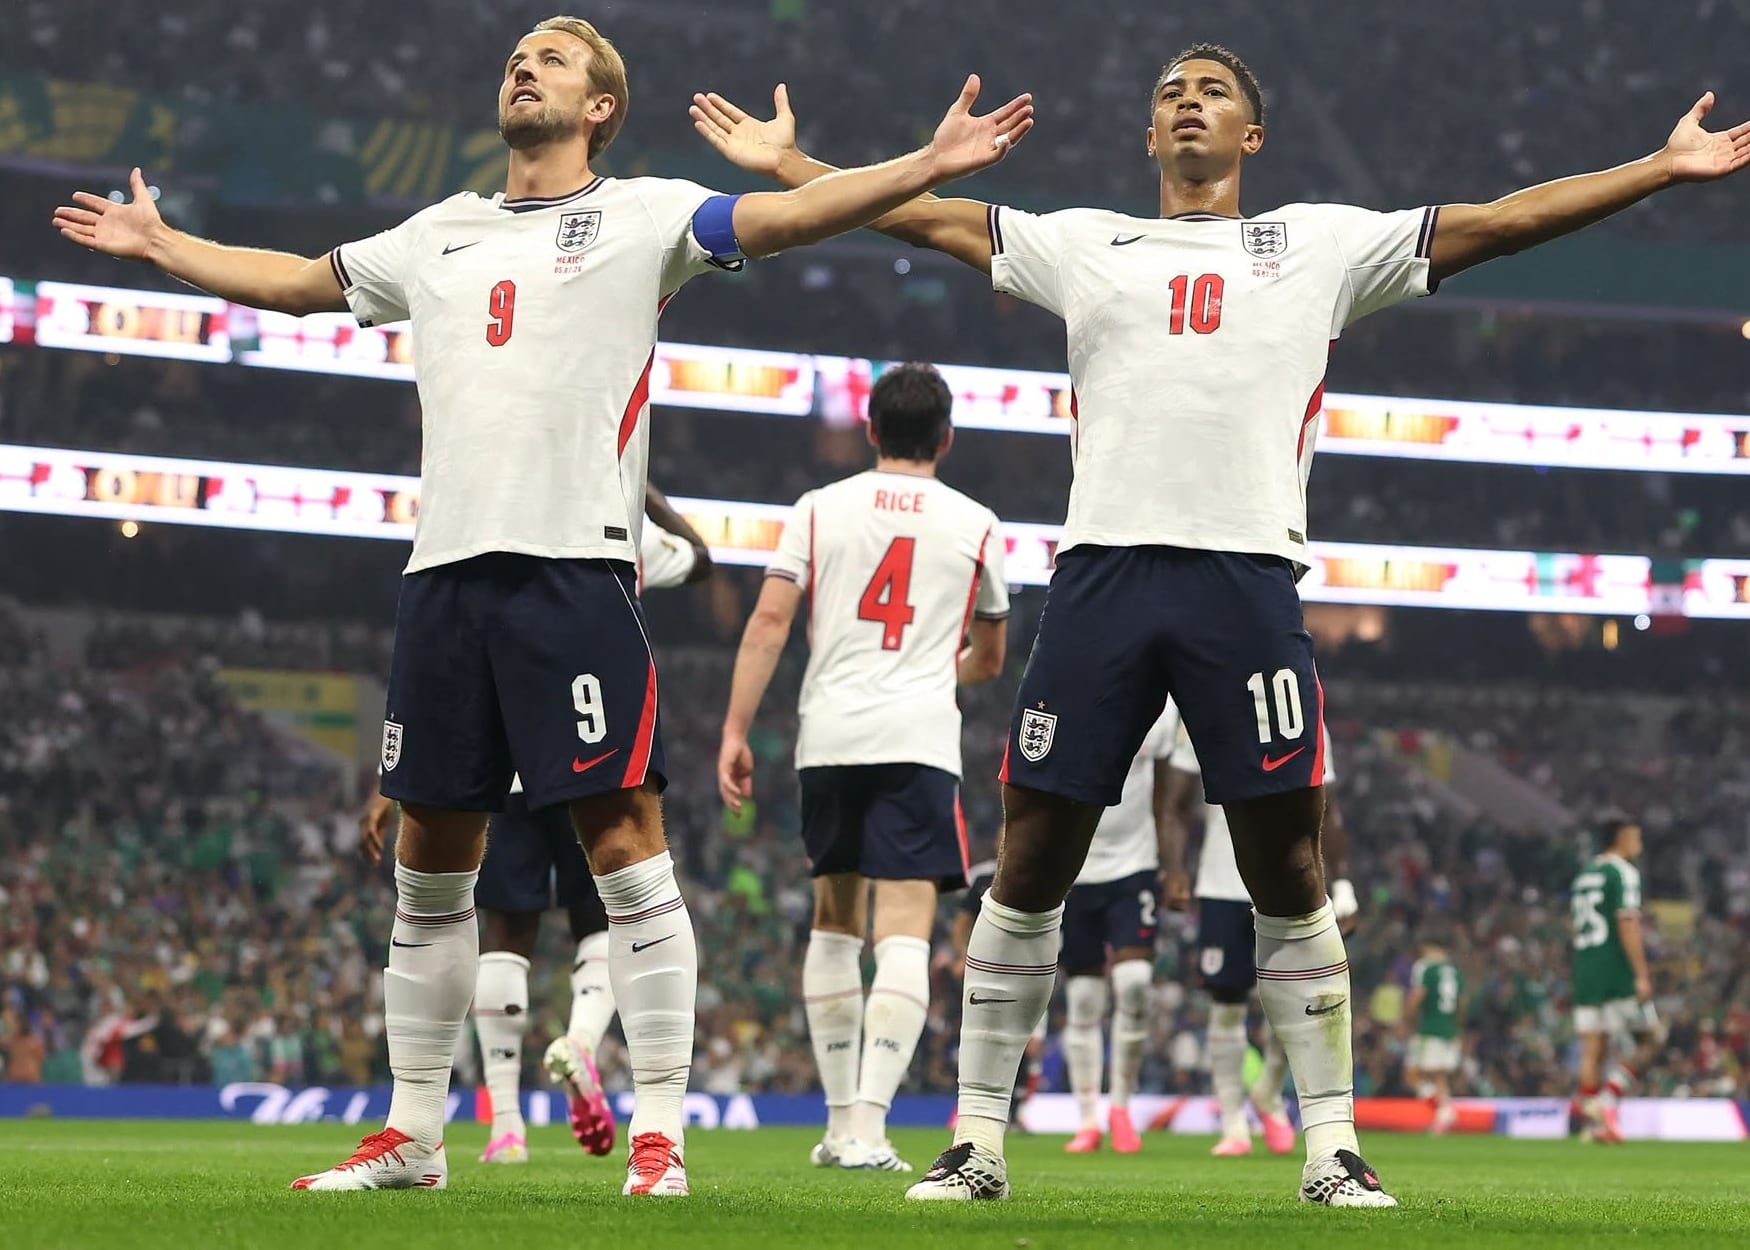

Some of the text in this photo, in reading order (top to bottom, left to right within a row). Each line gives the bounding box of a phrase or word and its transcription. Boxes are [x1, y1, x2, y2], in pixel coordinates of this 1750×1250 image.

[556, 255, 585, 264] MEXICO
[486, 279, 516, 347] 9
[1168, 273, 1225, 335] 10
[874, 489, 926, 513] RICE
[857, 536, 916, 651] 4
[571, 673, 607, 744] 9
[1246, 668, 1305, 744] 10
